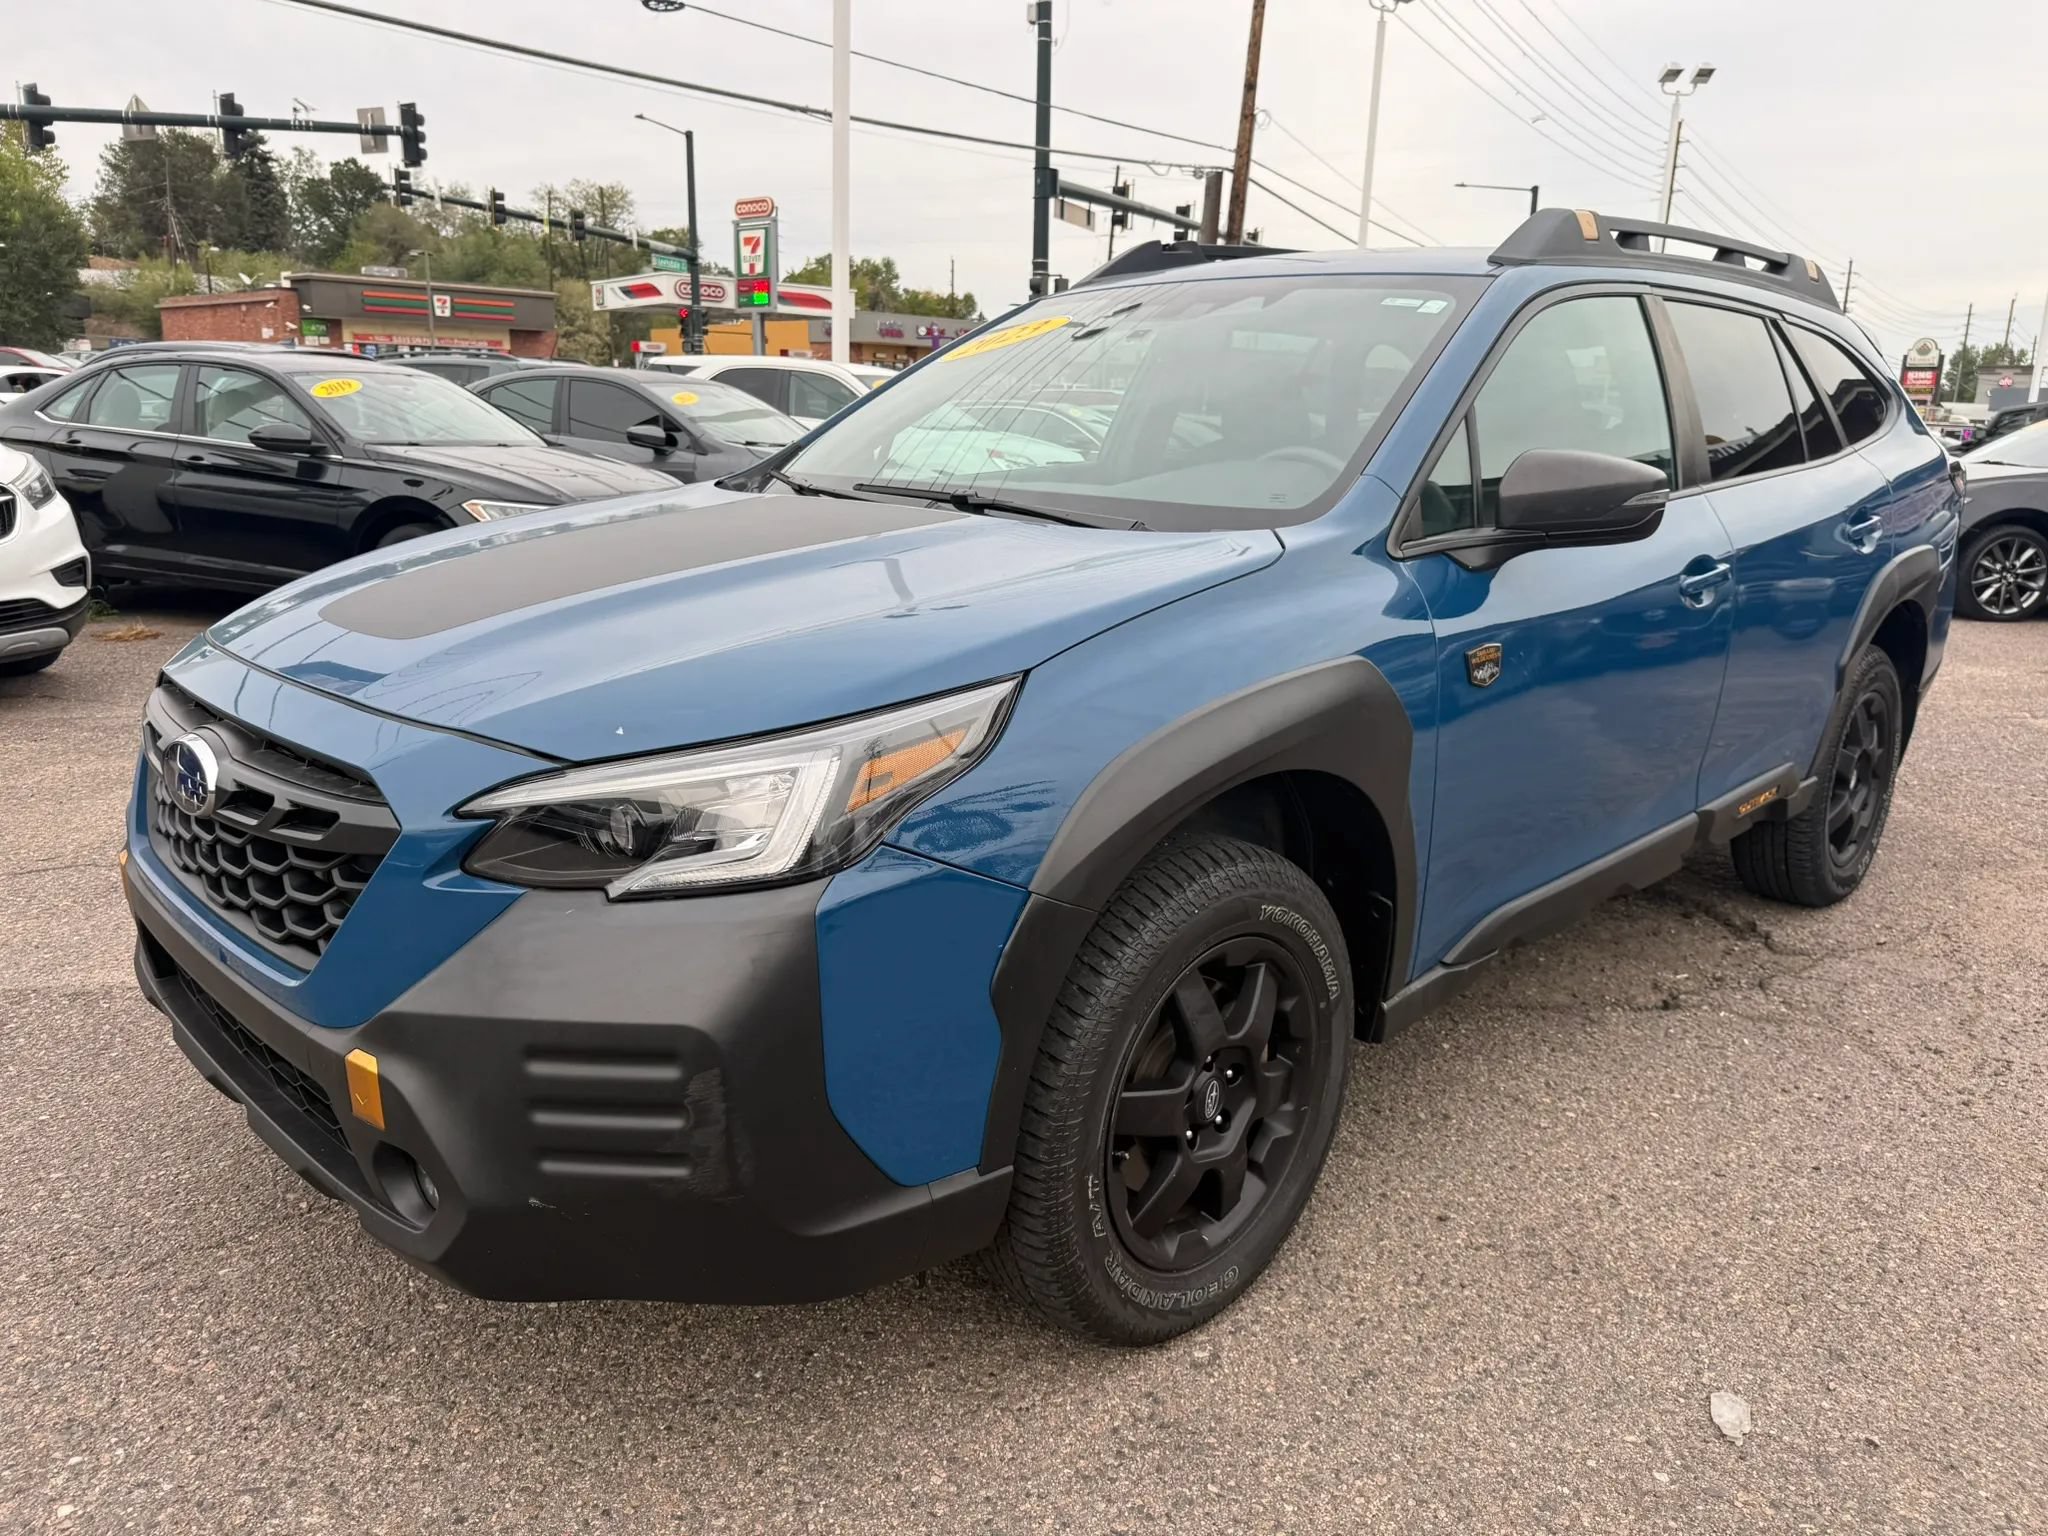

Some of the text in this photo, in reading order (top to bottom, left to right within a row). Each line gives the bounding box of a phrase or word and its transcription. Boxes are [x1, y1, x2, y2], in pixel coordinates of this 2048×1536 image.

[320, 380, 353, 396] 2019
[1259, 904, 1341, 1000] YOKOHAMA
[1105, 1250, 1239, 1310] GEOLANDAR
